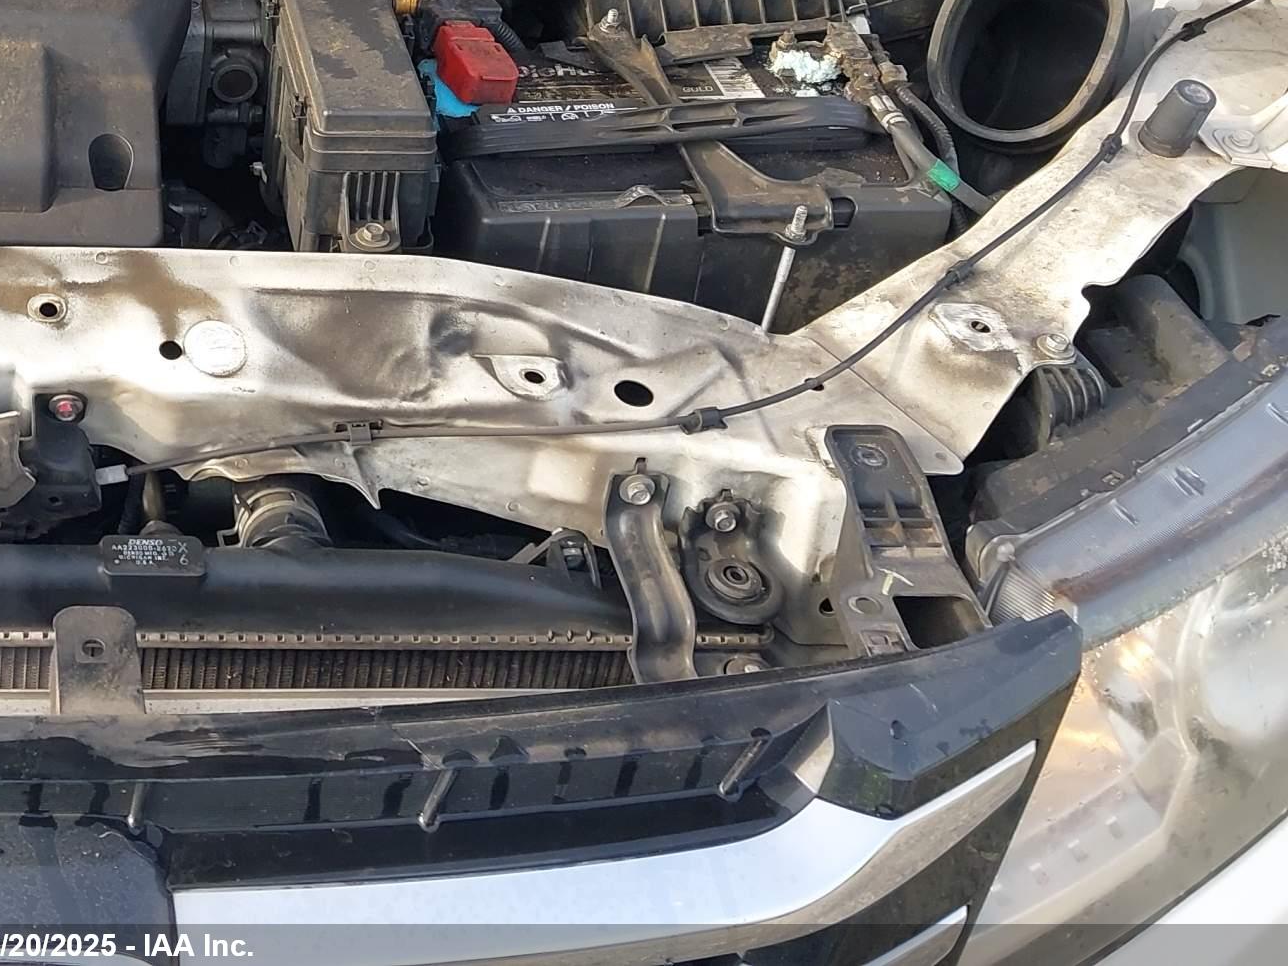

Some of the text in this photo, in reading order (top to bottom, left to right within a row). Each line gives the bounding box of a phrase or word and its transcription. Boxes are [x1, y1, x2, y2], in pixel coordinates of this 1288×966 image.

[517, 105, 563, 113] DANGER
[572, 103, 615, 111] POISON
[128, 538, 163, 546] DENSO
